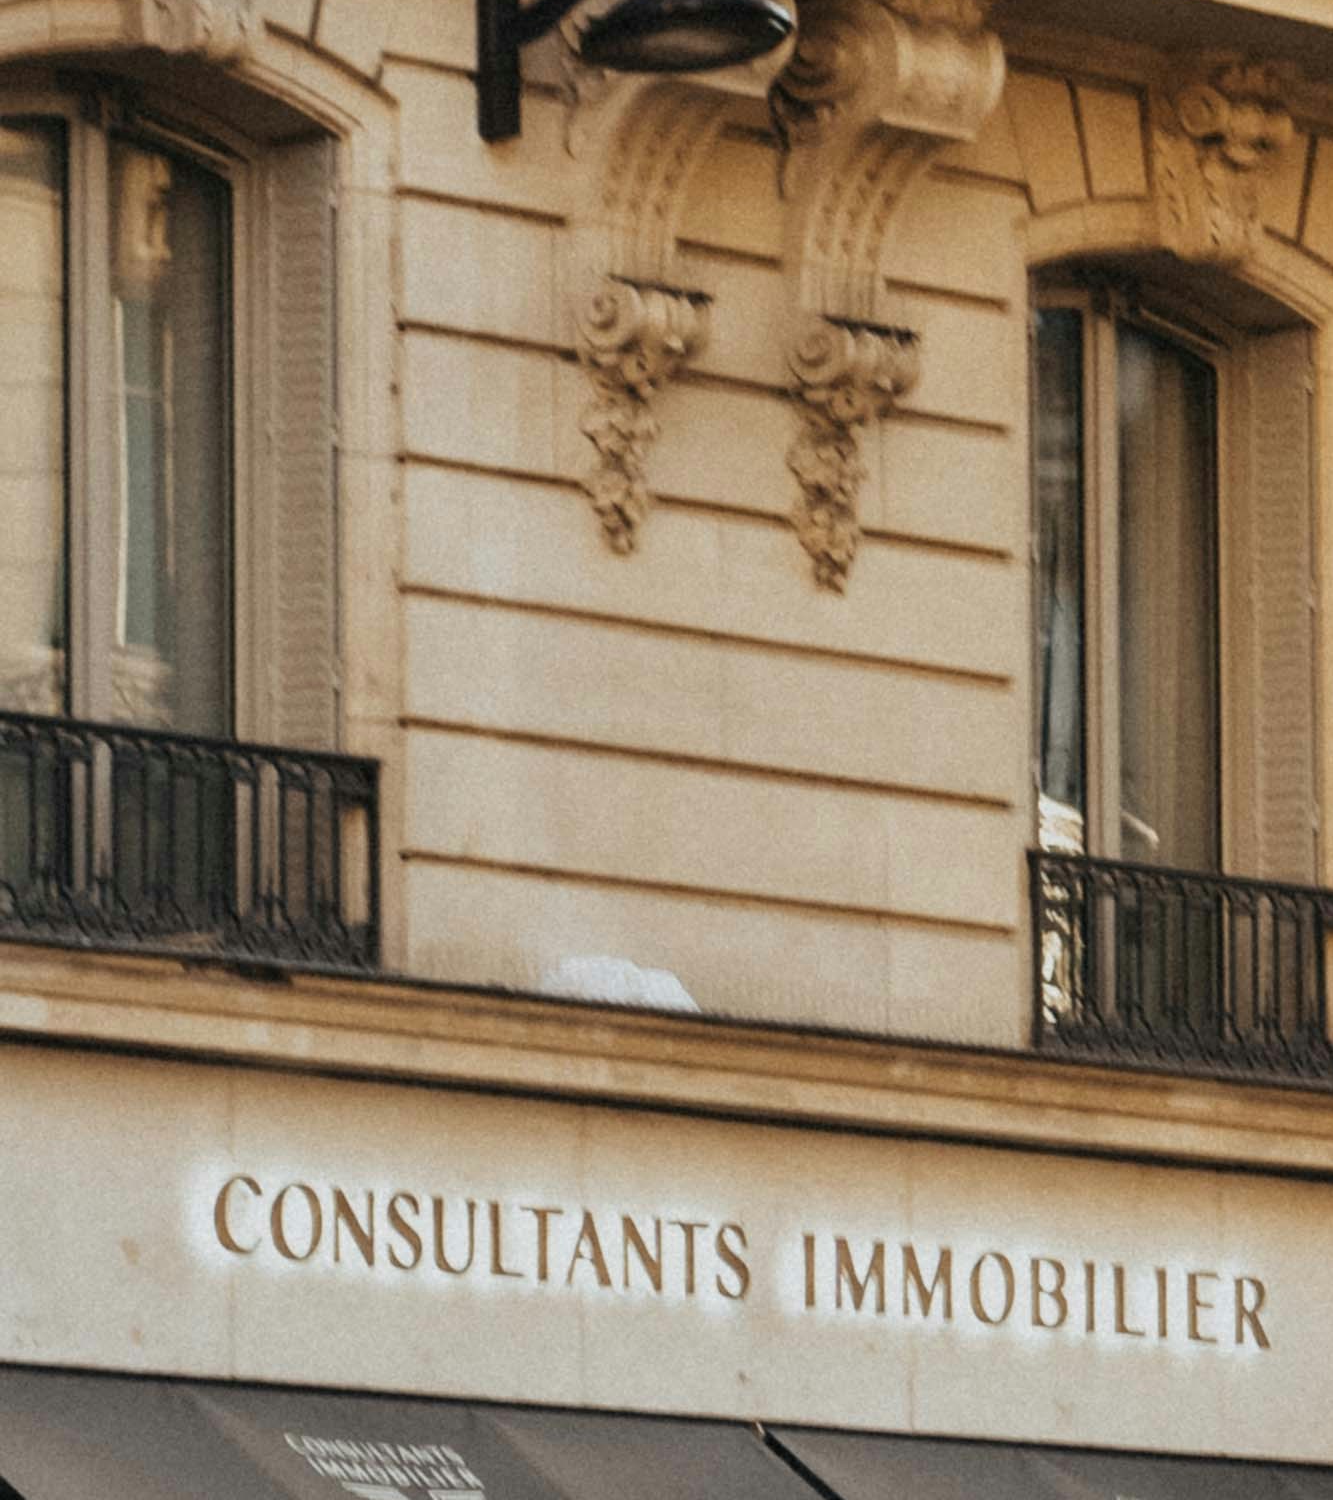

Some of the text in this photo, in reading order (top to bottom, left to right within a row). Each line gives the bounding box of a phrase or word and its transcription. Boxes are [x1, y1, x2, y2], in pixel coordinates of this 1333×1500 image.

[214, 1173, 1272, 1349] CONSULTANTS IMMOBILIER
[284, 1432, 466, 1468] CONSULTANTS
